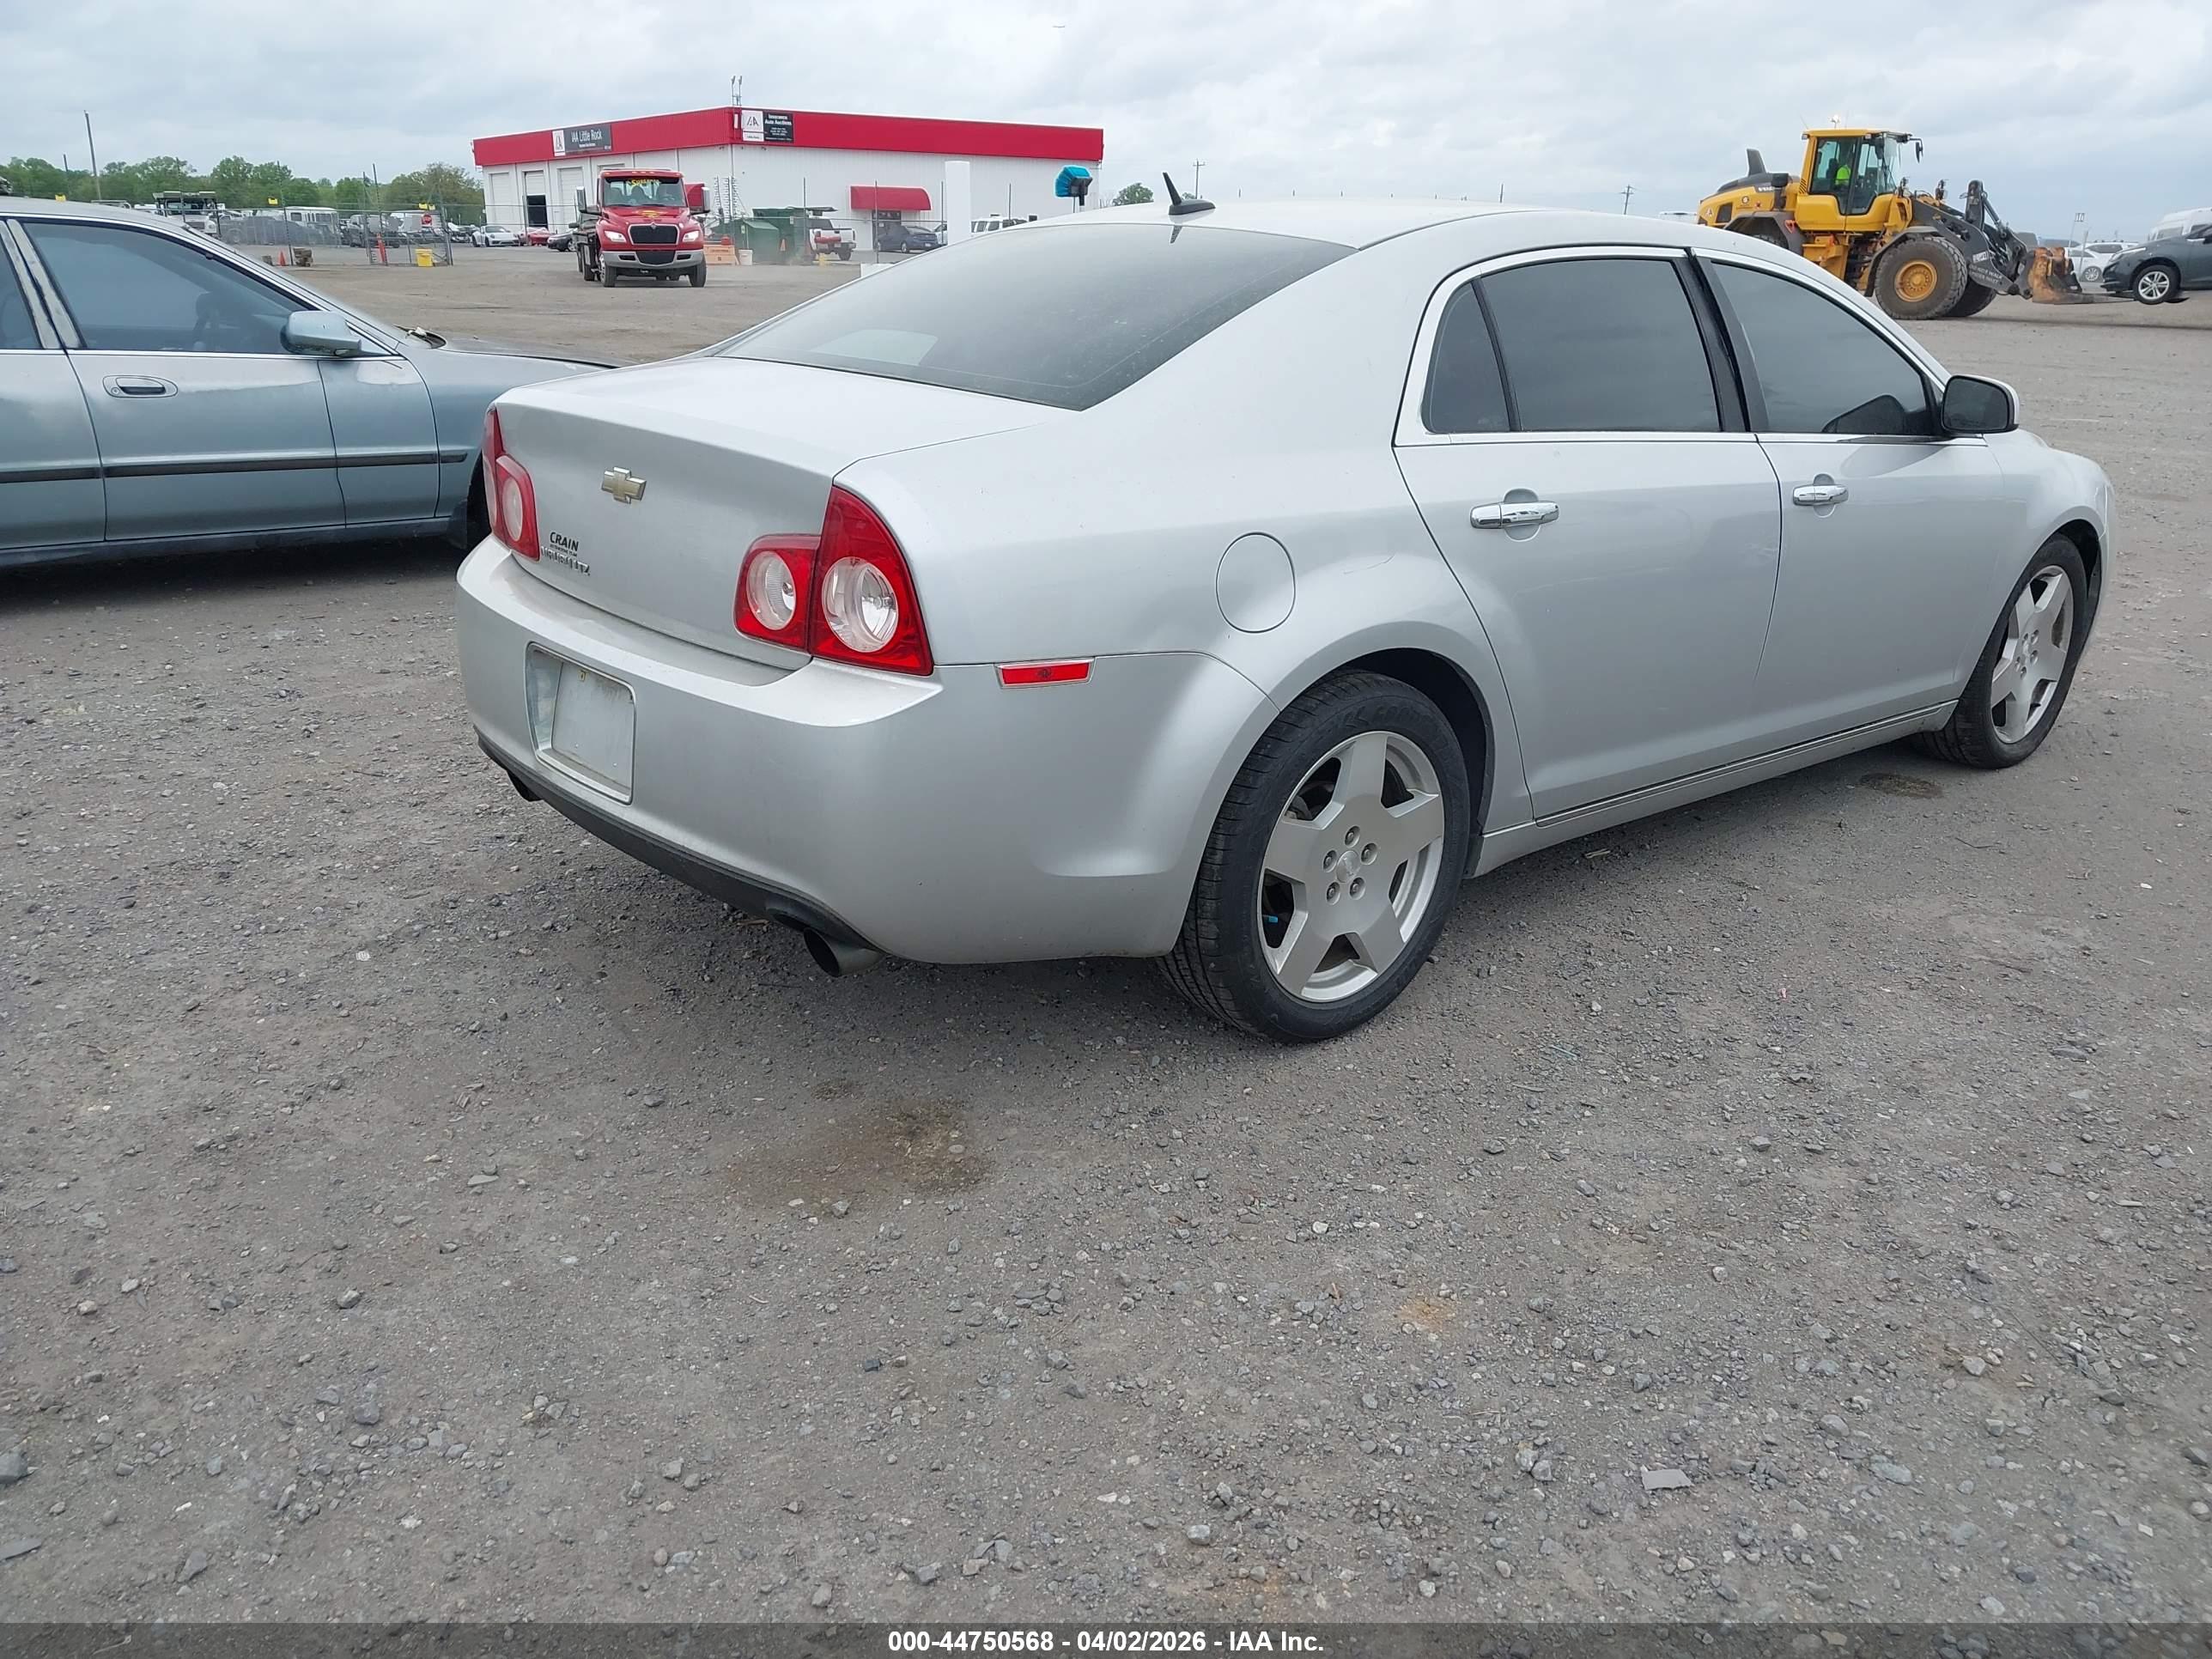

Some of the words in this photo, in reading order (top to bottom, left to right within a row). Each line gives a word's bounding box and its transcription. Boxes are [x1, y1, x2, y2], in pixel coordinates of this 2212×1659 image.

[580, 130, 590, 142] Little
[591, 129, 602, 140] Rock
[550, 532, 579, 551] CRAIN
